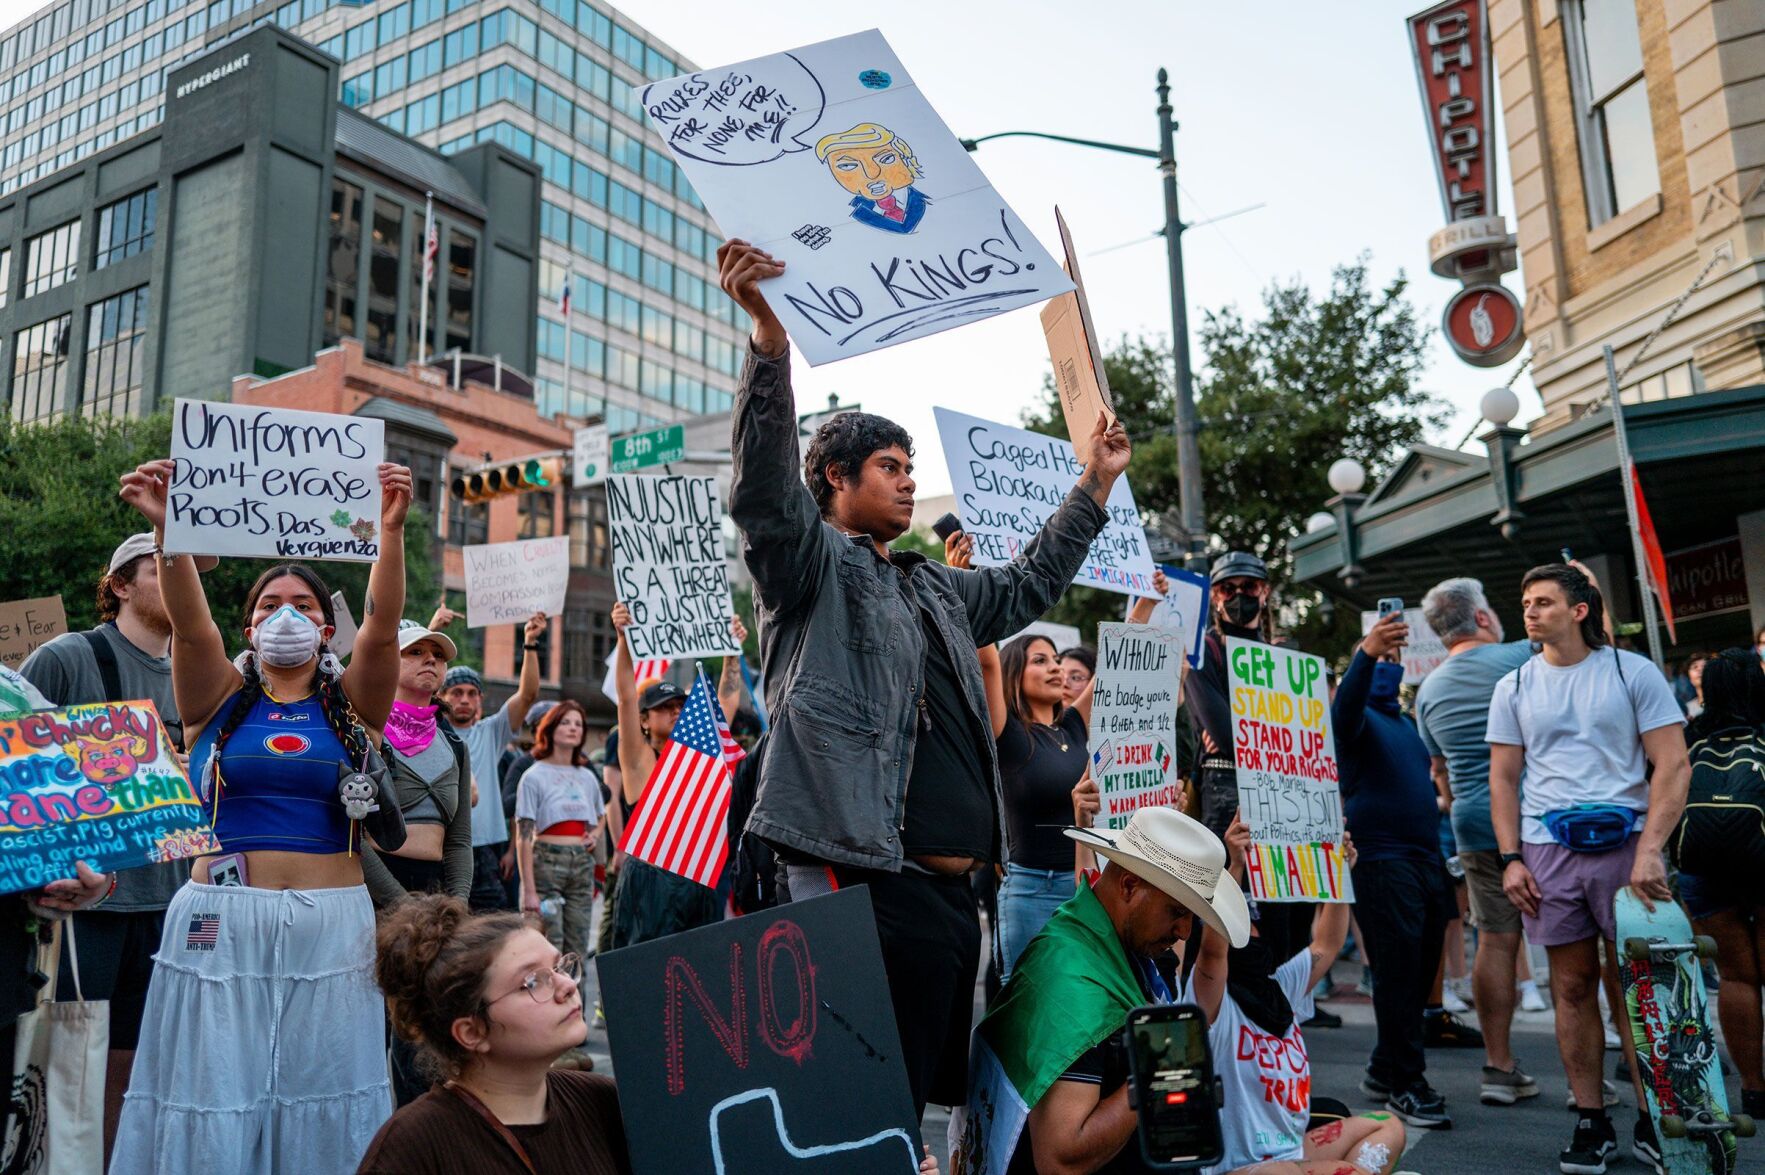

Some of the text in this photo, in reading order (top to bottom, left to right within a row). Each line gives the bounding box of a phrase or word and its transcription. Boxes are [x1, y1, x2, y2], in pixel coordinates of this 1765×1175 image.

[176, 53, 250, 98] HYPERGIANT
[649, 74, 709, 124] RULES
[671, 72, 752, 142] FOR THEE,
[1426, 10, 1481, 219] CHIPOTLE
[703, 85, 776, 154] NONE FOR
[745, 94, 797, 142] ME!!
[182, 402, 365, 466] Uniforms
[624, 436, 652, 458] 8th
[657, 428, 670, 443] ST
[968, 426, 1089, 476] Caged He
[262, 467, 371, 503] erase
[606, 476, 721, 525] INJUSTICE
[277, 511, 325, 537] Das
[964, 494, 1024, 533] Same
[1104, 505, 1140, 528] here
[276, 537, 378, 558] Vergüenza
[469, 550, 517, 572] WHEN
[611, 524, 723, 565] ANYWHERE
[1089, 547, 1118, 568] FREE
[472, 571, 526, 592] BECOMES
[617, 564, 728, 599] IS A THREAT
[1086, 566, 1151, 592] IMMIGRANTS
[1667, 551, 1742, 599] hipotle
[490, 603, 545, 619] RADICA
[623, 593, 731, 625] TO JUSTICE
[1712, 593, 1747, 609] GRIL
[26, 609, 56, 636] Fear
[629, 620, 739, 657] EVERYWHERE
[0, 651, 24, 662] ever
[1286, 655, 1319, 698] UP
[1094, 678, 1111, 707] the
[1116, 684, 1143, 714] badge
[1232, 687, 1293, 724] STAND
[18, 705, 159, 764] Chucky
[1101, 717, 1106, 733] A
[1236, 719, 1324, 760] STAND UP
[1116, 743, 1153, 765] I DRINK
[1236, 748, 1262, 771] FOR
[1265, 751, 1297, 775] YOUR
[1104, 768, 1165, 793] MY TEQUILA
[0, 772, 193, 829] ane than
[1109, 785, 1177, 815] WARM BECAUSE
[1240, 787, 1300, 825] THIS
[1, 823, 79, 850] ascist,
[117, 803, 200, 831] currently
[49, 832, 126, 862] around
[130, 824, 167, 848] the
[1248, 823, 1268, 840] bout
[0, 872, 24, 892] al
[1245, 841, 1345, 900] HUMANITY
[185, 942, 216, 951] ANTI-TRUMP
[664, 919, 818, 1096] NO
[1260, 1074, 1311, 1113] TRUM
